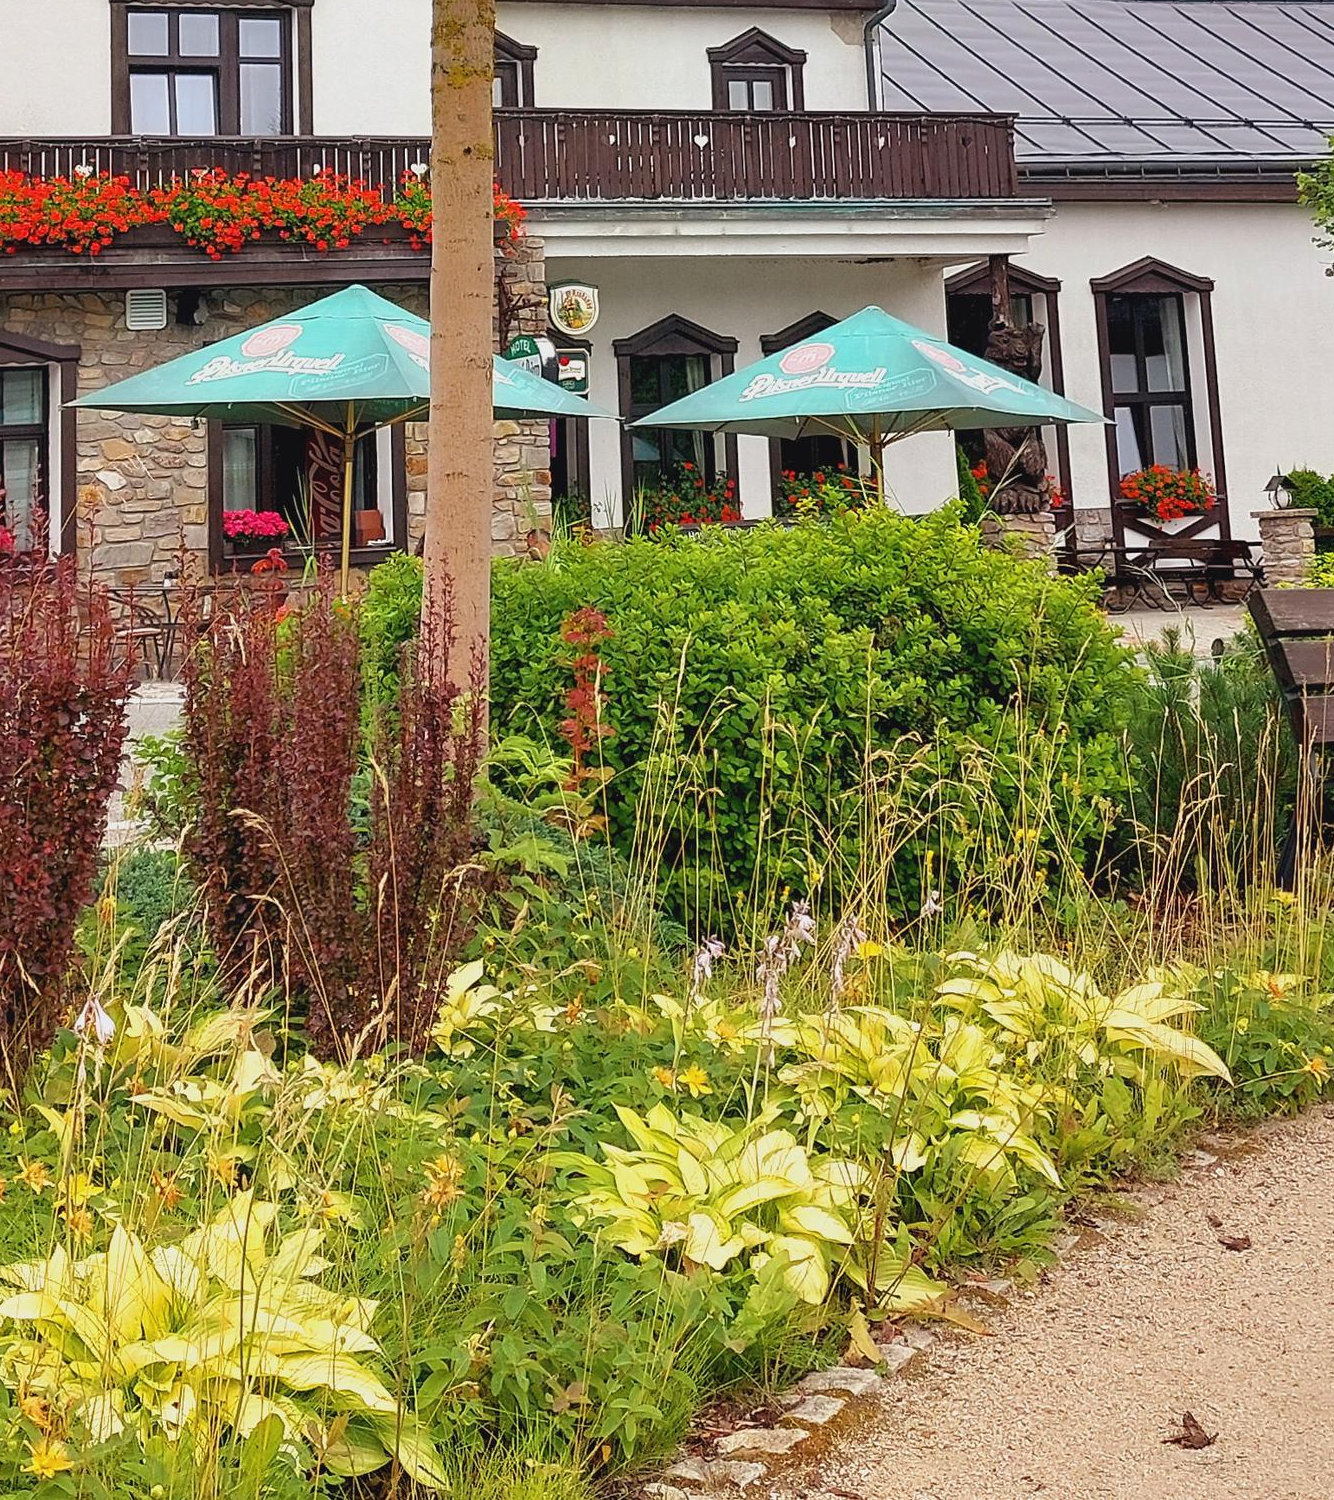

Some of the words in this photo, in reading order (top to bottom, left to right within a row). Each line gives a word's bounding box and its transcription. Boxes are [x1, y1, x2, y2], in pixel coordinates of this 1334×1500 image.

[510, 339, 532, 357] HOTEL
[268, 349, 347, 376] Urquell
[738, 373, 816, 403] Pilsner
[812, 364, 888, 389] Urquell
